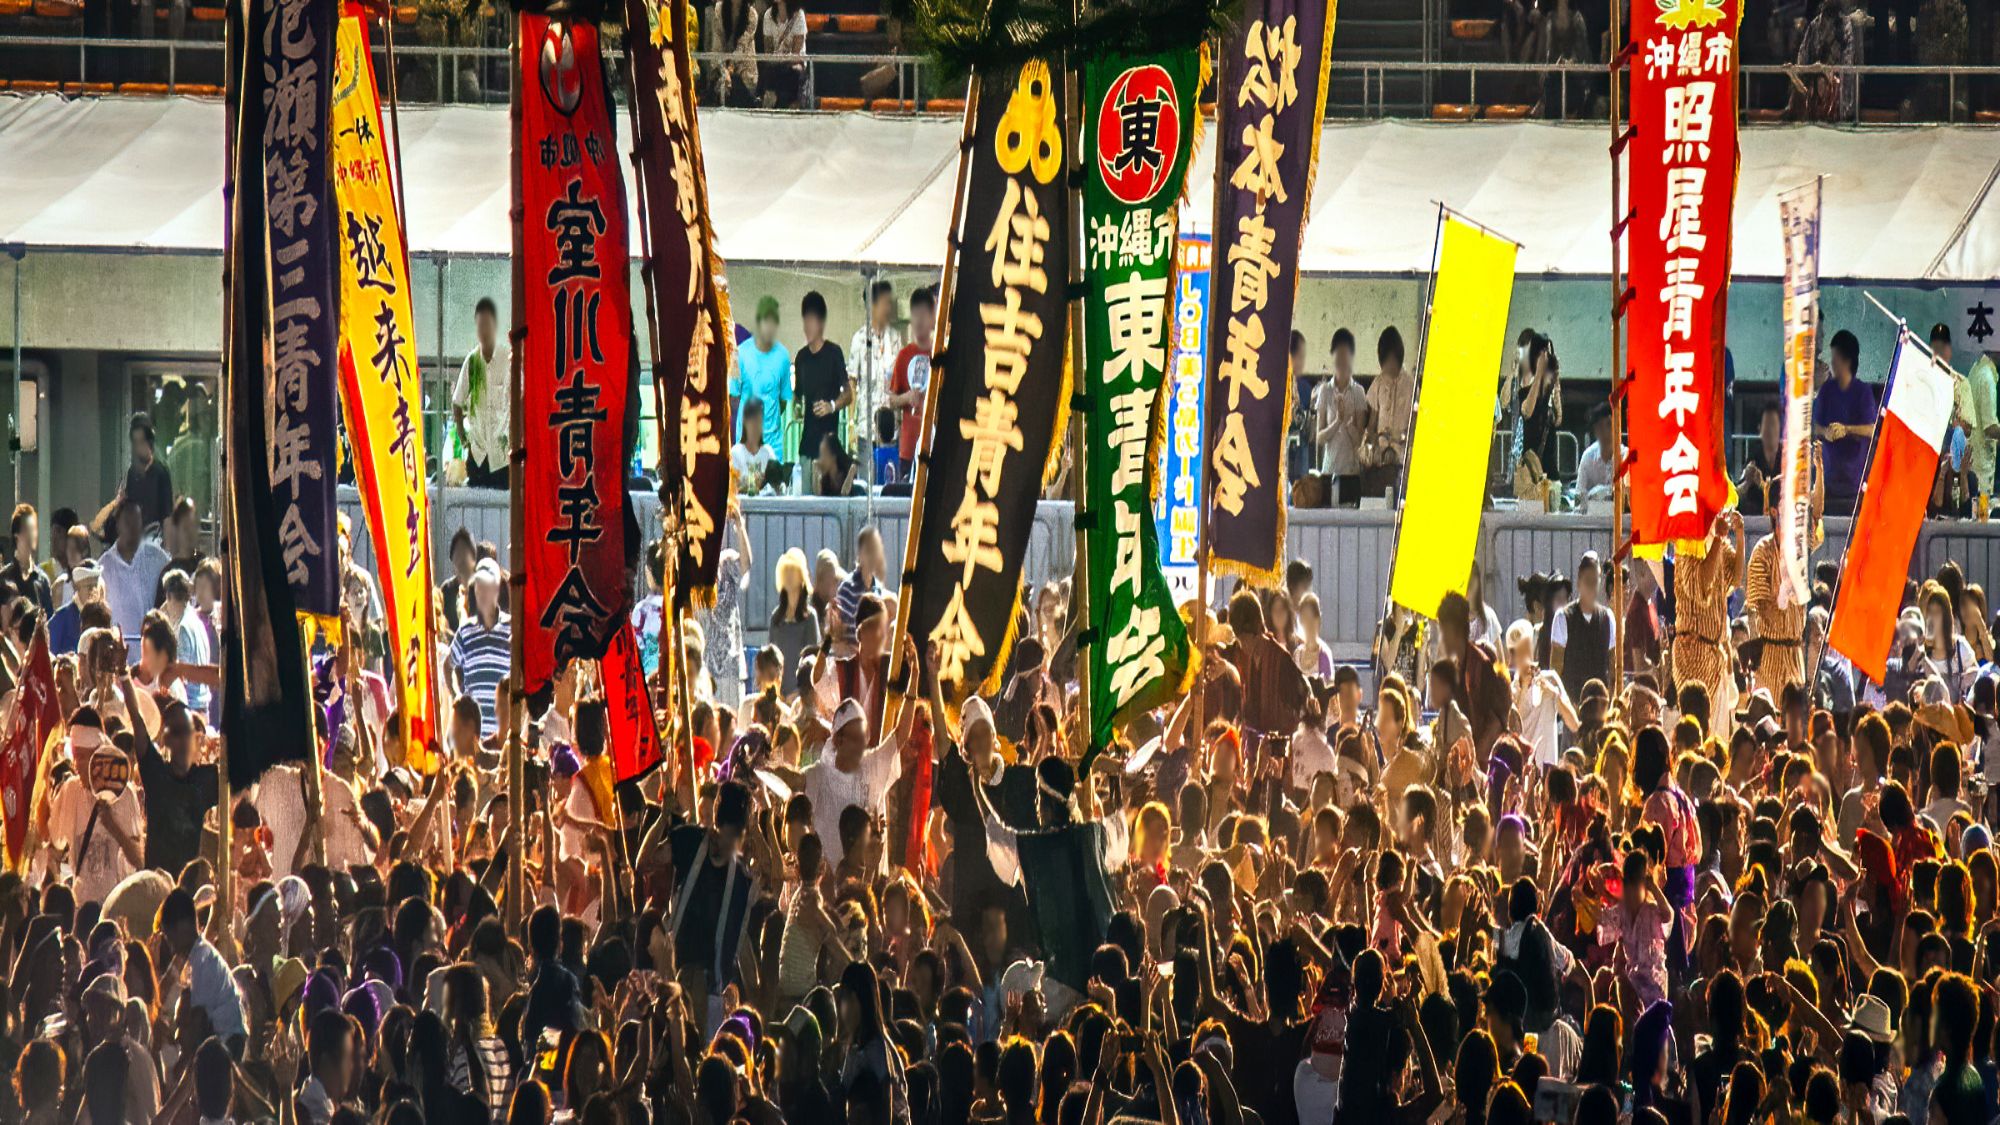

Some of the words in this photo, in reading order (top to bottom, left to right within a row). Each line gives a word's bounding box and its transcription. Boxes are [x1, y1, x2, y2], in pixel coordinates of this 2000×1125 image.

[1115, 95, 1164, 172] 東
[1644, 31, 1733, 80] 沖縄市
[1658, 81, 1716, 516] 照屋青年会
[1967, 301, 1994, 344] 本
[929, 178, 1051, 686] 住吉青年会
[1103, 271, 1169, 710] 東青年会
